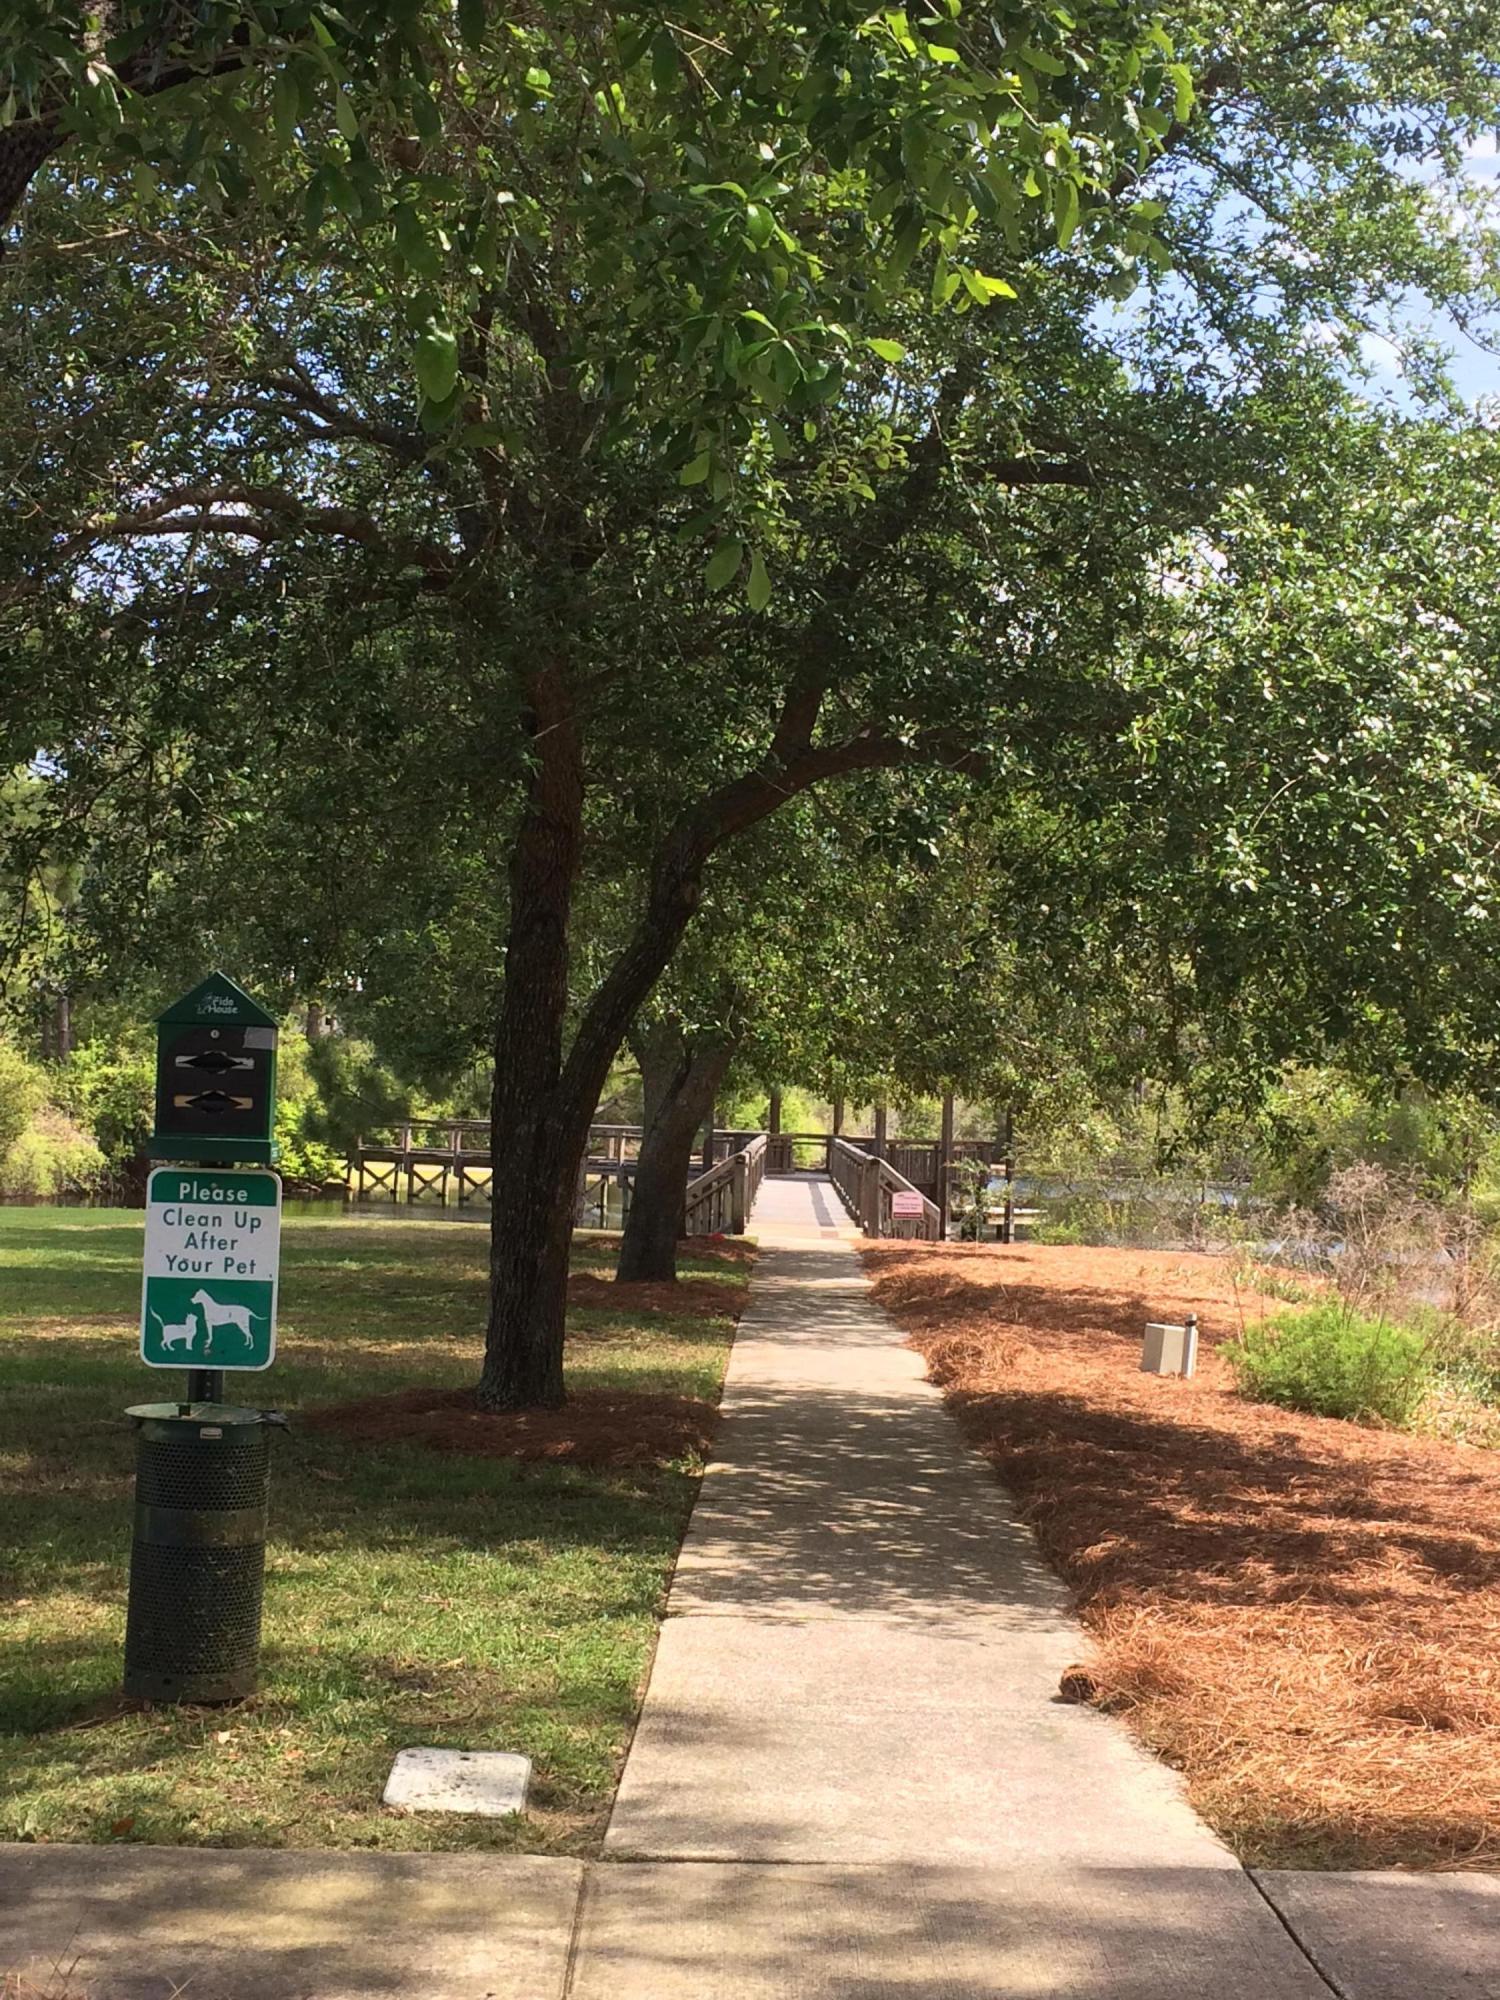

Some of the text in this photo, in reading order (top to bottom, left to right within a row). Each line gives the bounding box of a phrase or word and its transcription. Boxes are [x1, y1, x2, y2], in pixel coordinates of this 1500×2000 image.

[179, 1181, 249, 1202] Please
[163, 1207, 261, 1233] Clean Up
[184, 1231, 239, 1250] After
[166, 1254, 257, 1274] Your Pet
